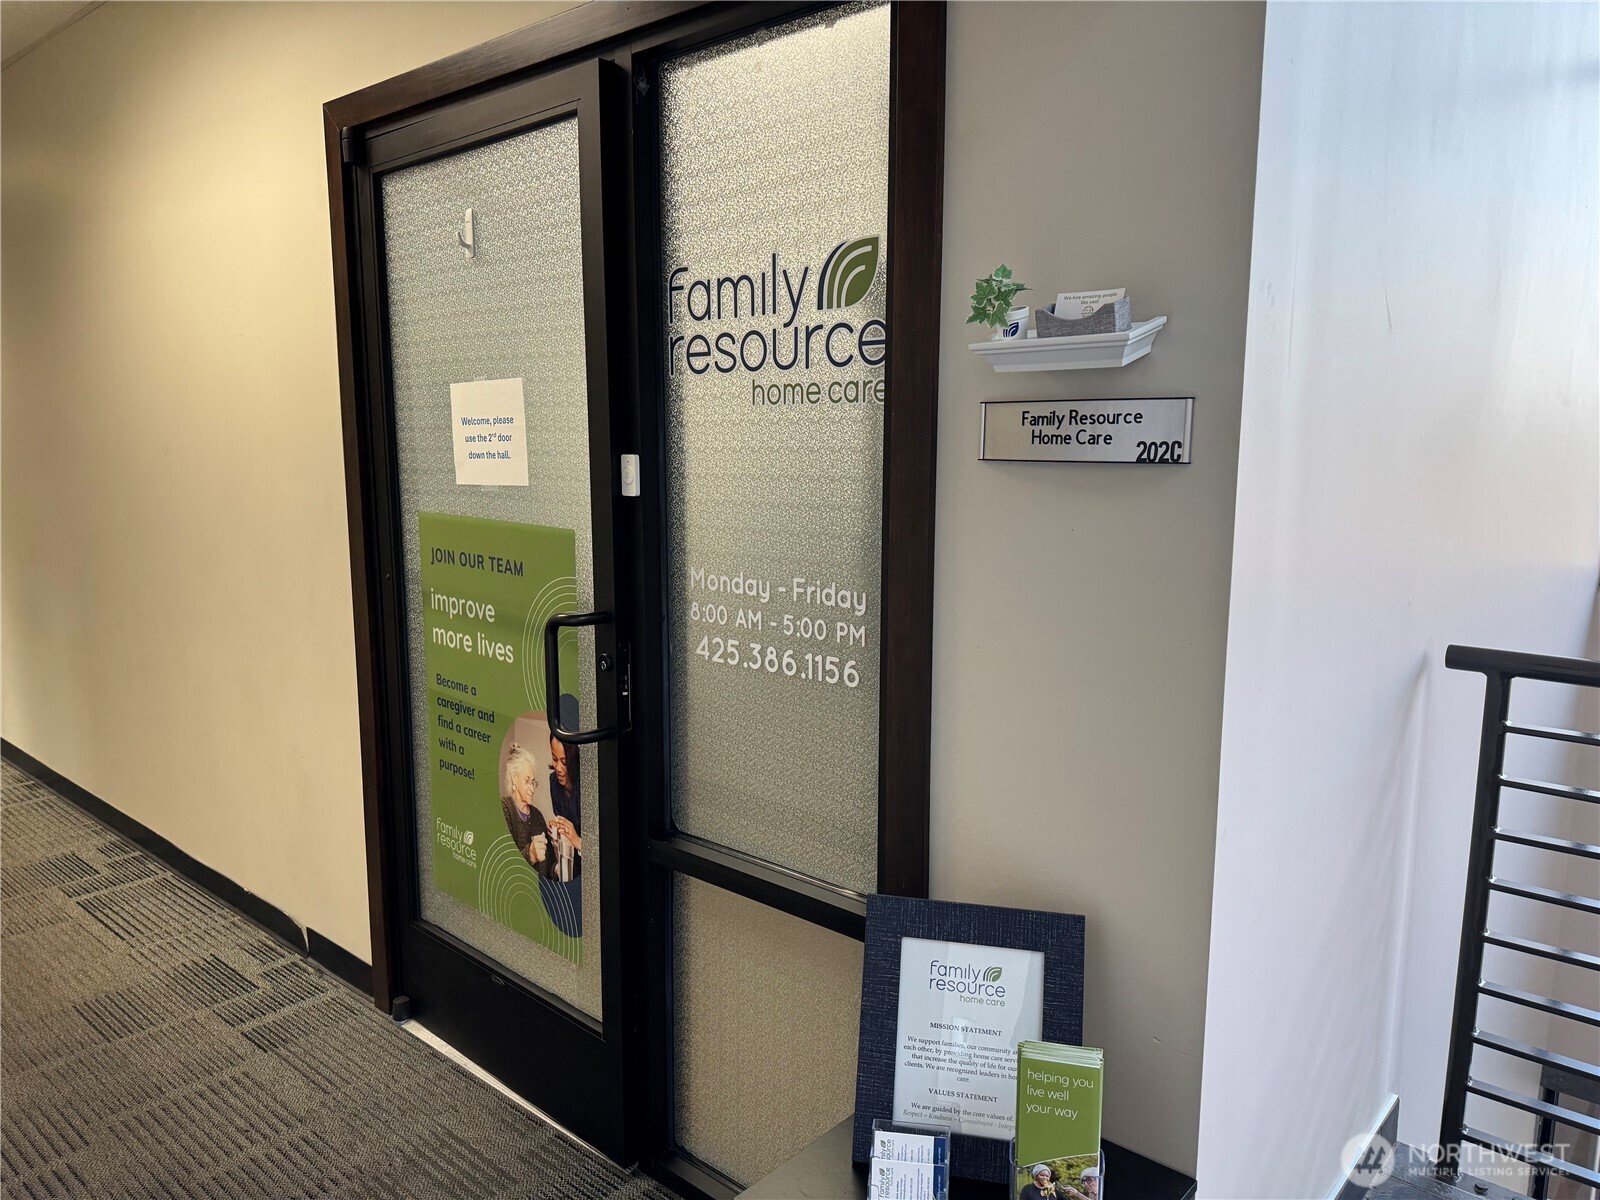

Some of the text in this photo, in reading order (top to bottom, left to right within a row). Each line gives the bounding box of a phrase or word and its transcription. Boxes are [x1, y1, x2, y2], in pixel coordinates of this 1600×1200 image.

[668, 252, 808, 328] family
[669, 319, 886, 376] resource
[752, 380, 885, 405] home care
[461, 416, 514, 426] Welcome, please
[1022, 409, 1144, 430] Family Resource
[477, 434, 487, 442] the
[498, 432, 512, 441] door
[1032, 429, 1112, 445] Home Care
[468, 451, 511, 459] down the hall.
[1136, 440, 1182, 463] 202C
[431, 547, 524, 577] JOIN OUR TEAM
[690, 566, 770, 603] Monday
[793, 578, 866, 616] Friday
[430, 588, 495, 623] improve
[690, 602, 727, 625] 8:00
[736, 608, 762, 630] AM
[783, 615, 826, 640] 5:00
[836, 622, 865, 647] PM
[433, 627, 513, 663] more lives
[696, 636, 860, 687] 425.386.1156
[436, 673, 476, 696] Become a
[437, 697, 494, 723] caregiver and
[438, 714, 491, 743] find a career
[439, 737, 464, 755] with a
[440, 759, 474, 780] purpose!
[436, 818, 463, 843] family
[437, 833, 476, 860] resource
[930, 960, 981, 983] family
[930, 977, 1005, 997] resource
[960, 994, 1005, 1007] home care
[930, 1022, 1002, 1036] MISSION STATEMENT
[917, 1046, 934, 1054] other,
[944, 1049, 972, 1059] providing
[919, 1038, 940, 1046] support
[941, 1040, 965, 1049] families,
[978, 1046, 1011, 1055] community
[924, 1054, 947, 1062] increase
[958, 1060, 979, 1068] quality
[987, 1061, 996, 1069] life
[946, 1067, 978, 1076] recognized
[979, 1070, 1000, 1079] leaders
[1027, 1068, 1094, 1089] helping you
[928, 1088, 998, 1103] VALUES STATEMENT
[1027, 1084, 1069, 1101] live well
[903, 1109, 922, 1118] Respect
[929, 1113, 952, 1121] Kindness
[998, 1122, 1015, 1131] Integr
[932, 1106, 952, 1114] guided
[1026, 1103, 1078, 1120] your way
